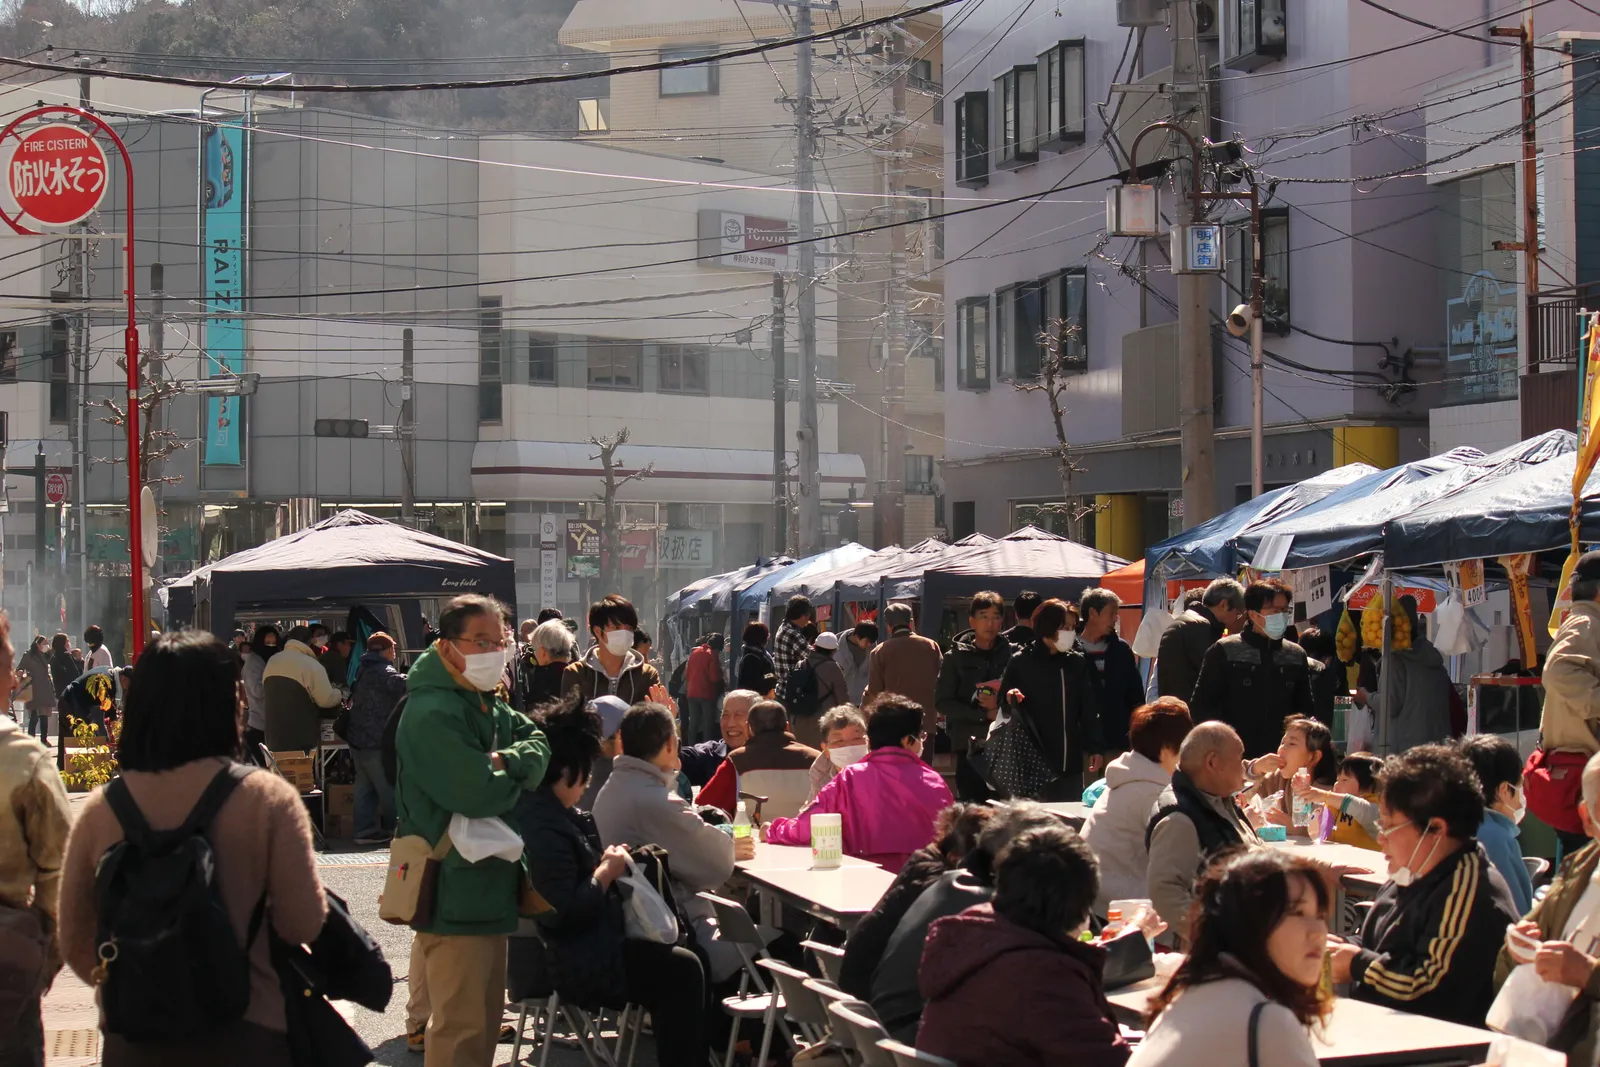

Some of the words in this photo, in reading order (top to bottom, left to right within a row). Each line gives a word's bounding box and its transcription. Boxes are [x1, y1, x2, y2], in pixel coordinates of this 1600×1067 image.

[23, 140, 45, 153] FIRE
[46, 138, 88, 152] CISTERN
[13, 156, 104, 198] 防火水そう
[1196, 230, 1212, 266] 明店街
[213, 239, 231, 325] RAIZE
